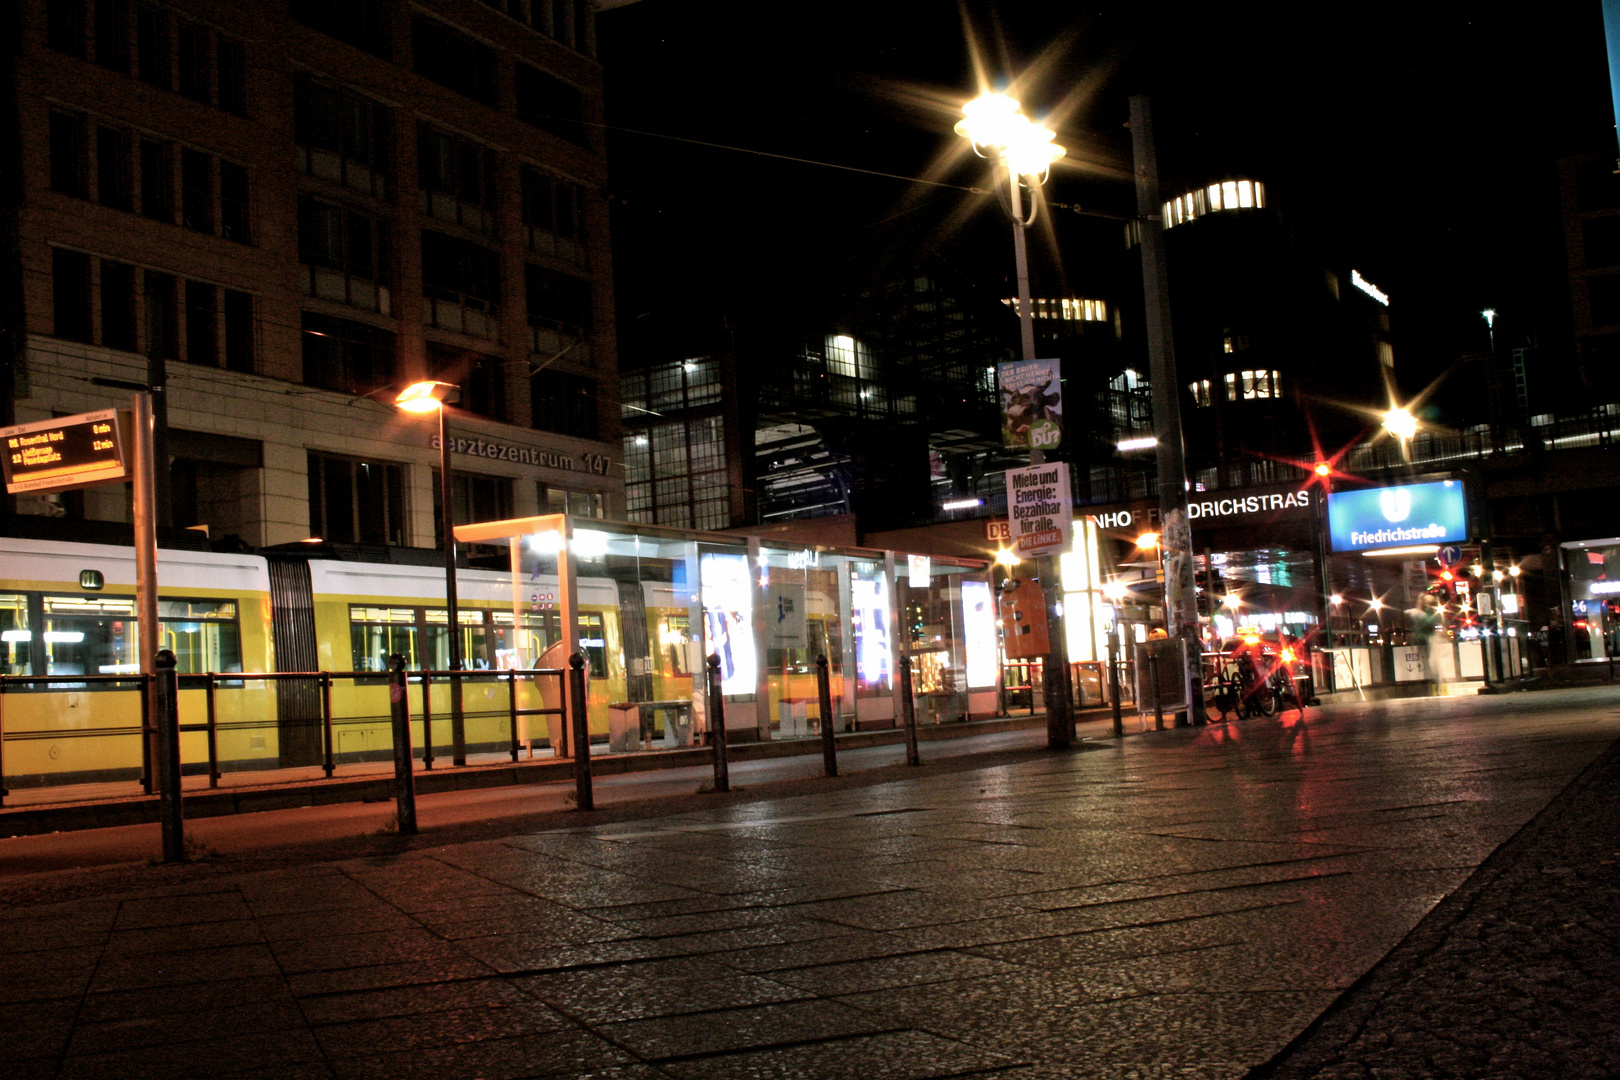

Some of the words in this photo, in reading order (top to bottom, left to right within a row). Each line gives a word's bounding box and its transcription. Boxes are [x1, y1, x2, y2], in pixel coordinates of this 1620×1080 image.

[1016, 363, 1038, 374] BAUER
[49, 431, 64, 441] Nord
[98, 424, 111, 433] min
[1032, 429, 1060, 448] DU?
[93, 440, 102, 451] 12
[101, 439, 113, 449] min
[431, 433, 575, 471] aerztezentrum
[585, 453, 611, 476] 147
[1012, 473, 1038, 489] Miete
[1039, 468, 1058, 485] und
[1015, 486, 1057, 504] Energie:
[1013, 501, 1061, 520] Bezahlbar
[1380, 488, 1411, 522] U
[989, 522, 1010, 538] DB
[1020, 518, 1034, 534] für
[1034, 516, 1057, 532] alle.
[1351, 523, 1446, 545] Friedrichstraße
[1021, 537, 1033, 548] DIE
[82, 571, 96, 587] M1
